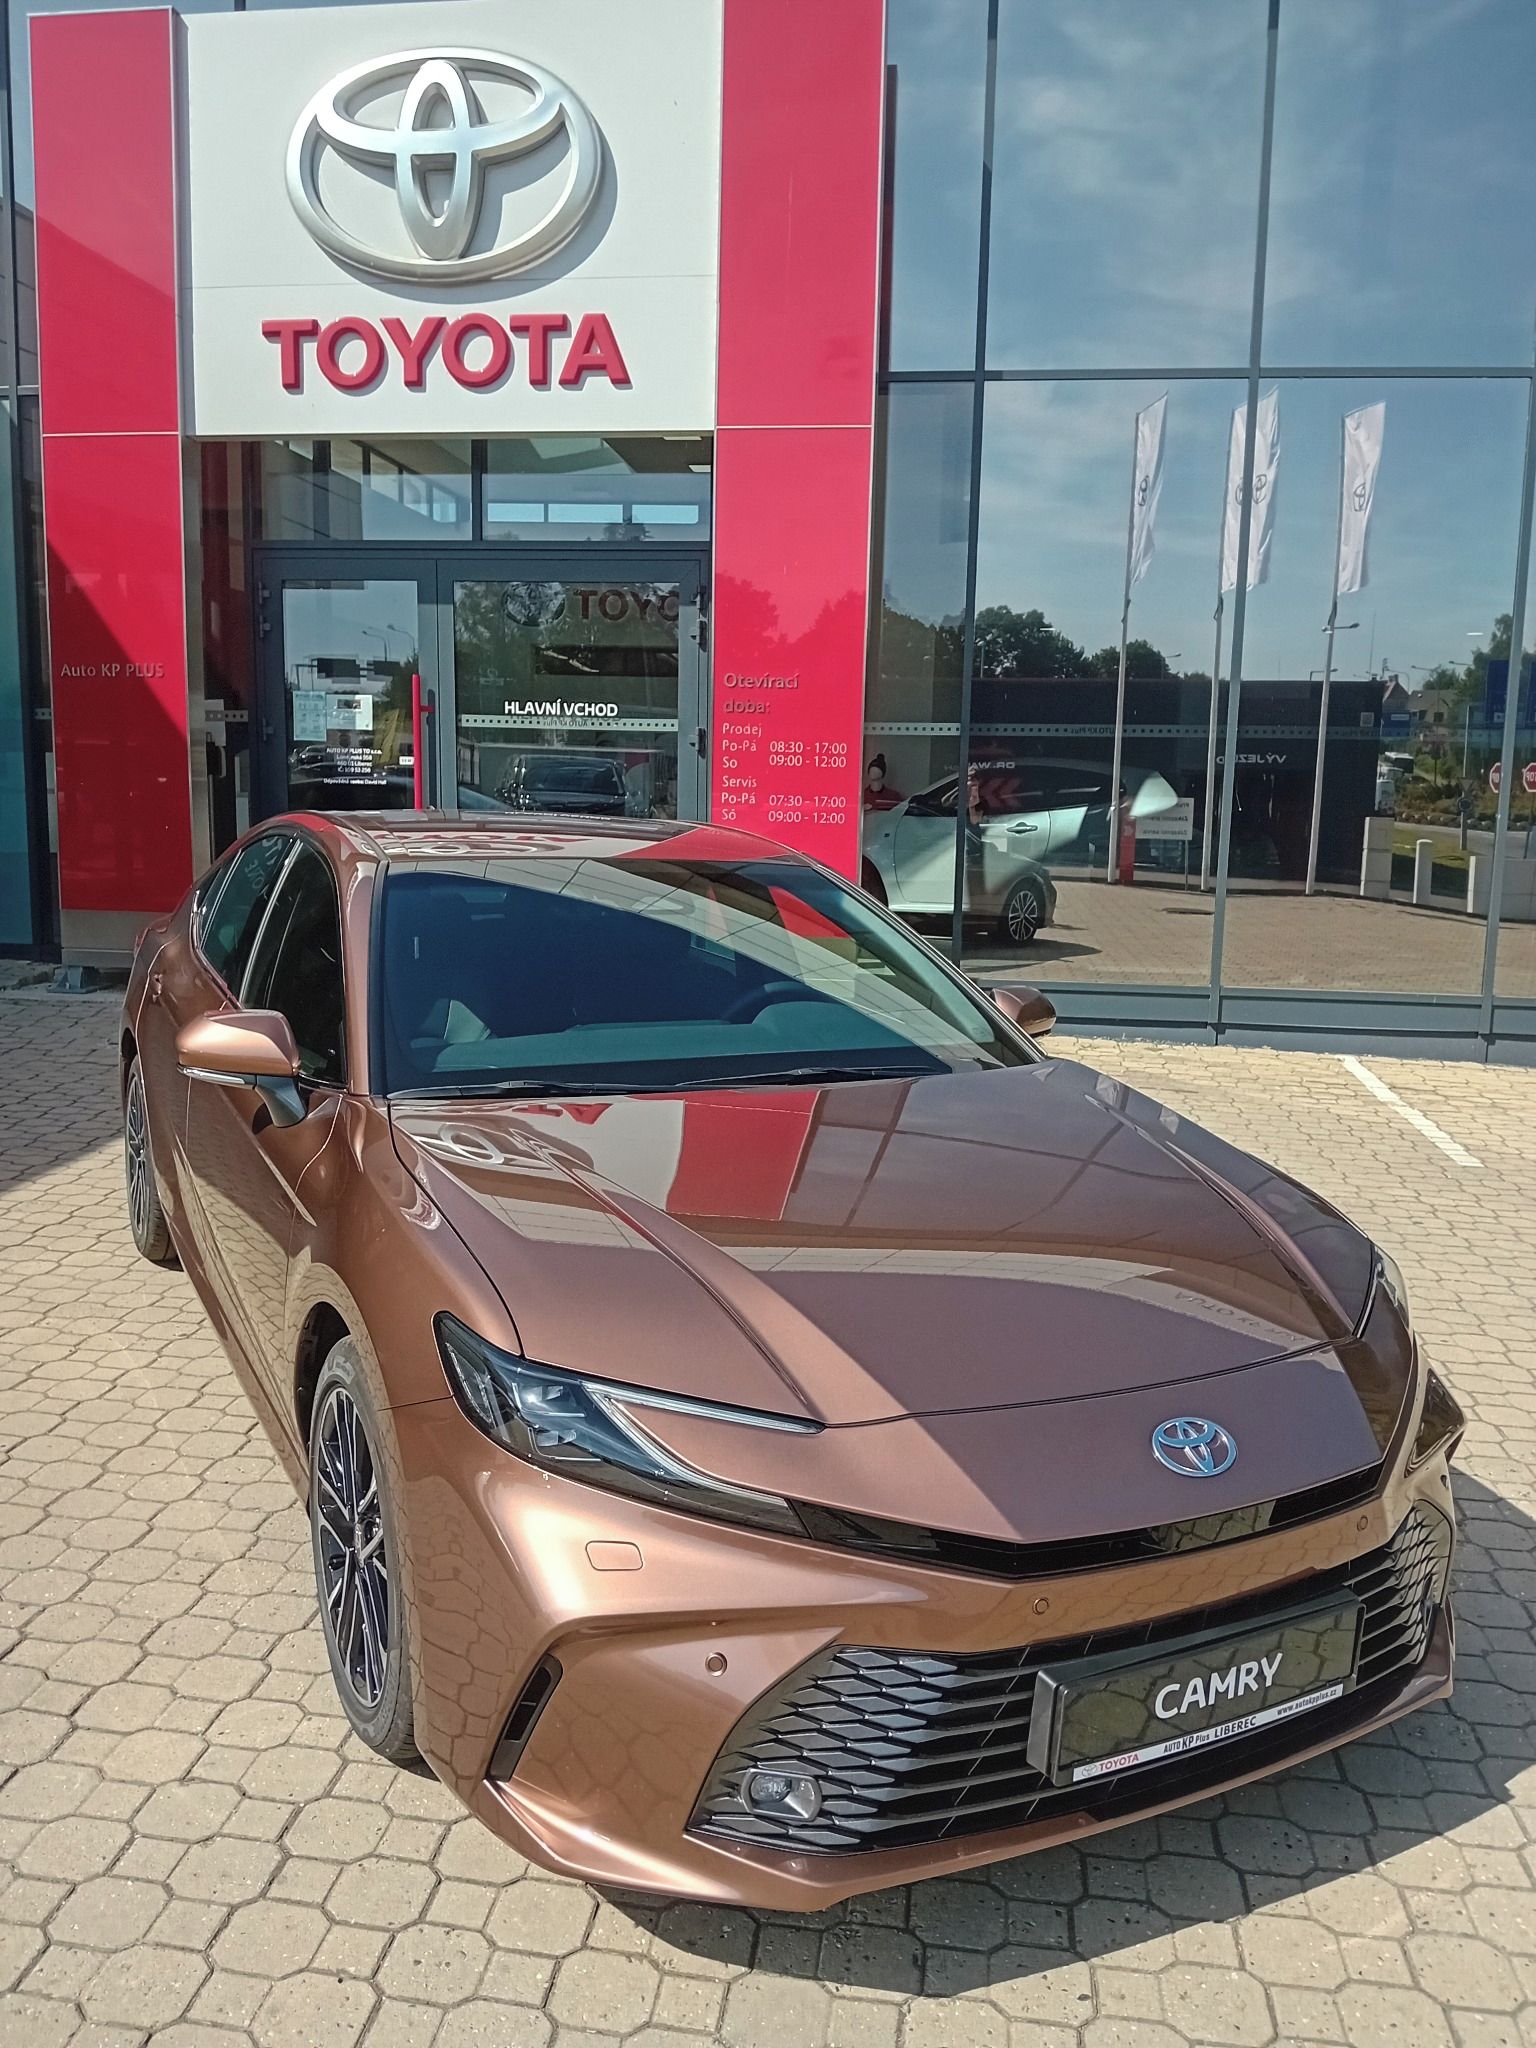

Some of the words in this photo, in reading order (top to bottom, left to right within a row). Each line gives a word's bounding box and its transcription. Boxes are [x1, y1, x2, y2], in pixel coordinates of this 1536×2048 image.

[262, 313, 632, 390] TOYOTA
[573, 589, 680, 621] TOYO
[60, 663, 96, 677] Auto
[101, 663, 121, 677] KP
[126, 662, 165, 678] PLUS
[724, 672, 799, 688] Otevírací
[504, 698, 562, 715] HLAVNÍ
[563, 702, 618, 717] VCHOD
[724, 699, 771, 713] doba:
[722, 722, 762, 738] Prodej
[722, 739, 757, 752] Po-Pá
[769, 740, 804, 753] 08:30
[814, 742, 847, 755] 17:00
[722, 756, 738, 769] So
[769, 754, 803, 767] 09:00
[814, 756, 846, 768] 12:00
[721, 776, 757, 788] Servis
[721, 792, 756, 804] Po-Pá
[769, 795, 802, 807] 07:30
[814, 796, 846, 808] 17:00
[768, 810, 802, 822] 09:00
[813, 812, 845, 824] 12:00
[1155, 1652, 1283, 1719] CAMRY
[1099, 1753, 1139, 1772] TOYOTA
[1163, 1740, 1181, 1754] AUTO
[1181, 1734, 1195, 1750] KP
[1195, 1733, 1210, 1745] Plus
[1214, 1716, 1257, 1739] LIBEREC
[1276, 1689, 1337, 1716] www.autokpplus.cz
